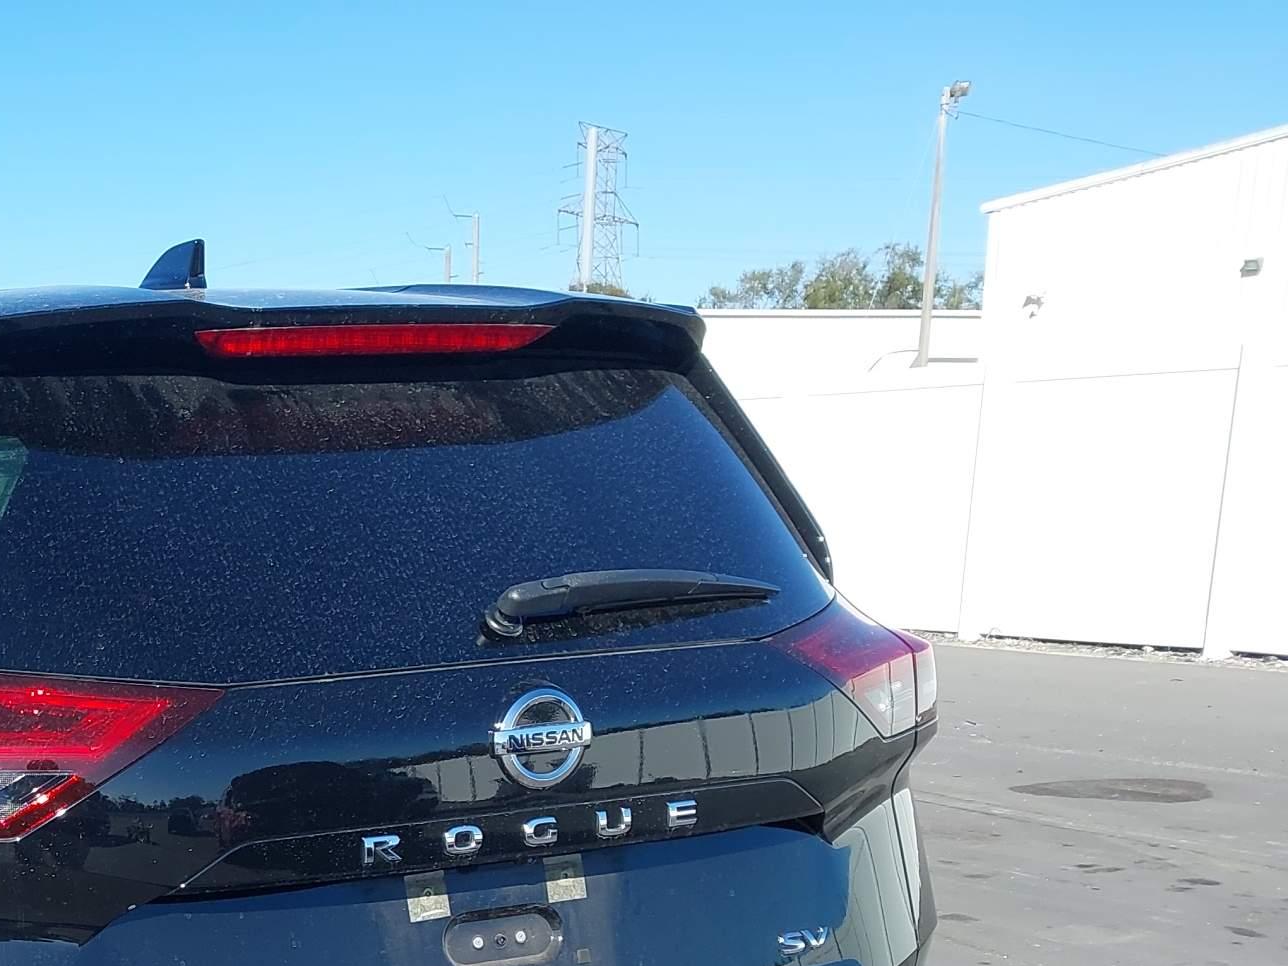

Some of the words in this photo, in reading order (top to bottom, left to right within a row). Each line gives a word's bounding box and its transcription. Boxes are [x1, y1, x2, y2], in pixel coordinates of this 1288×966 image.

[508, 727, 584, 750] NISSAN
[362, 800, 698, 865] ROGUE
[778, 927, 829, 957] SV
